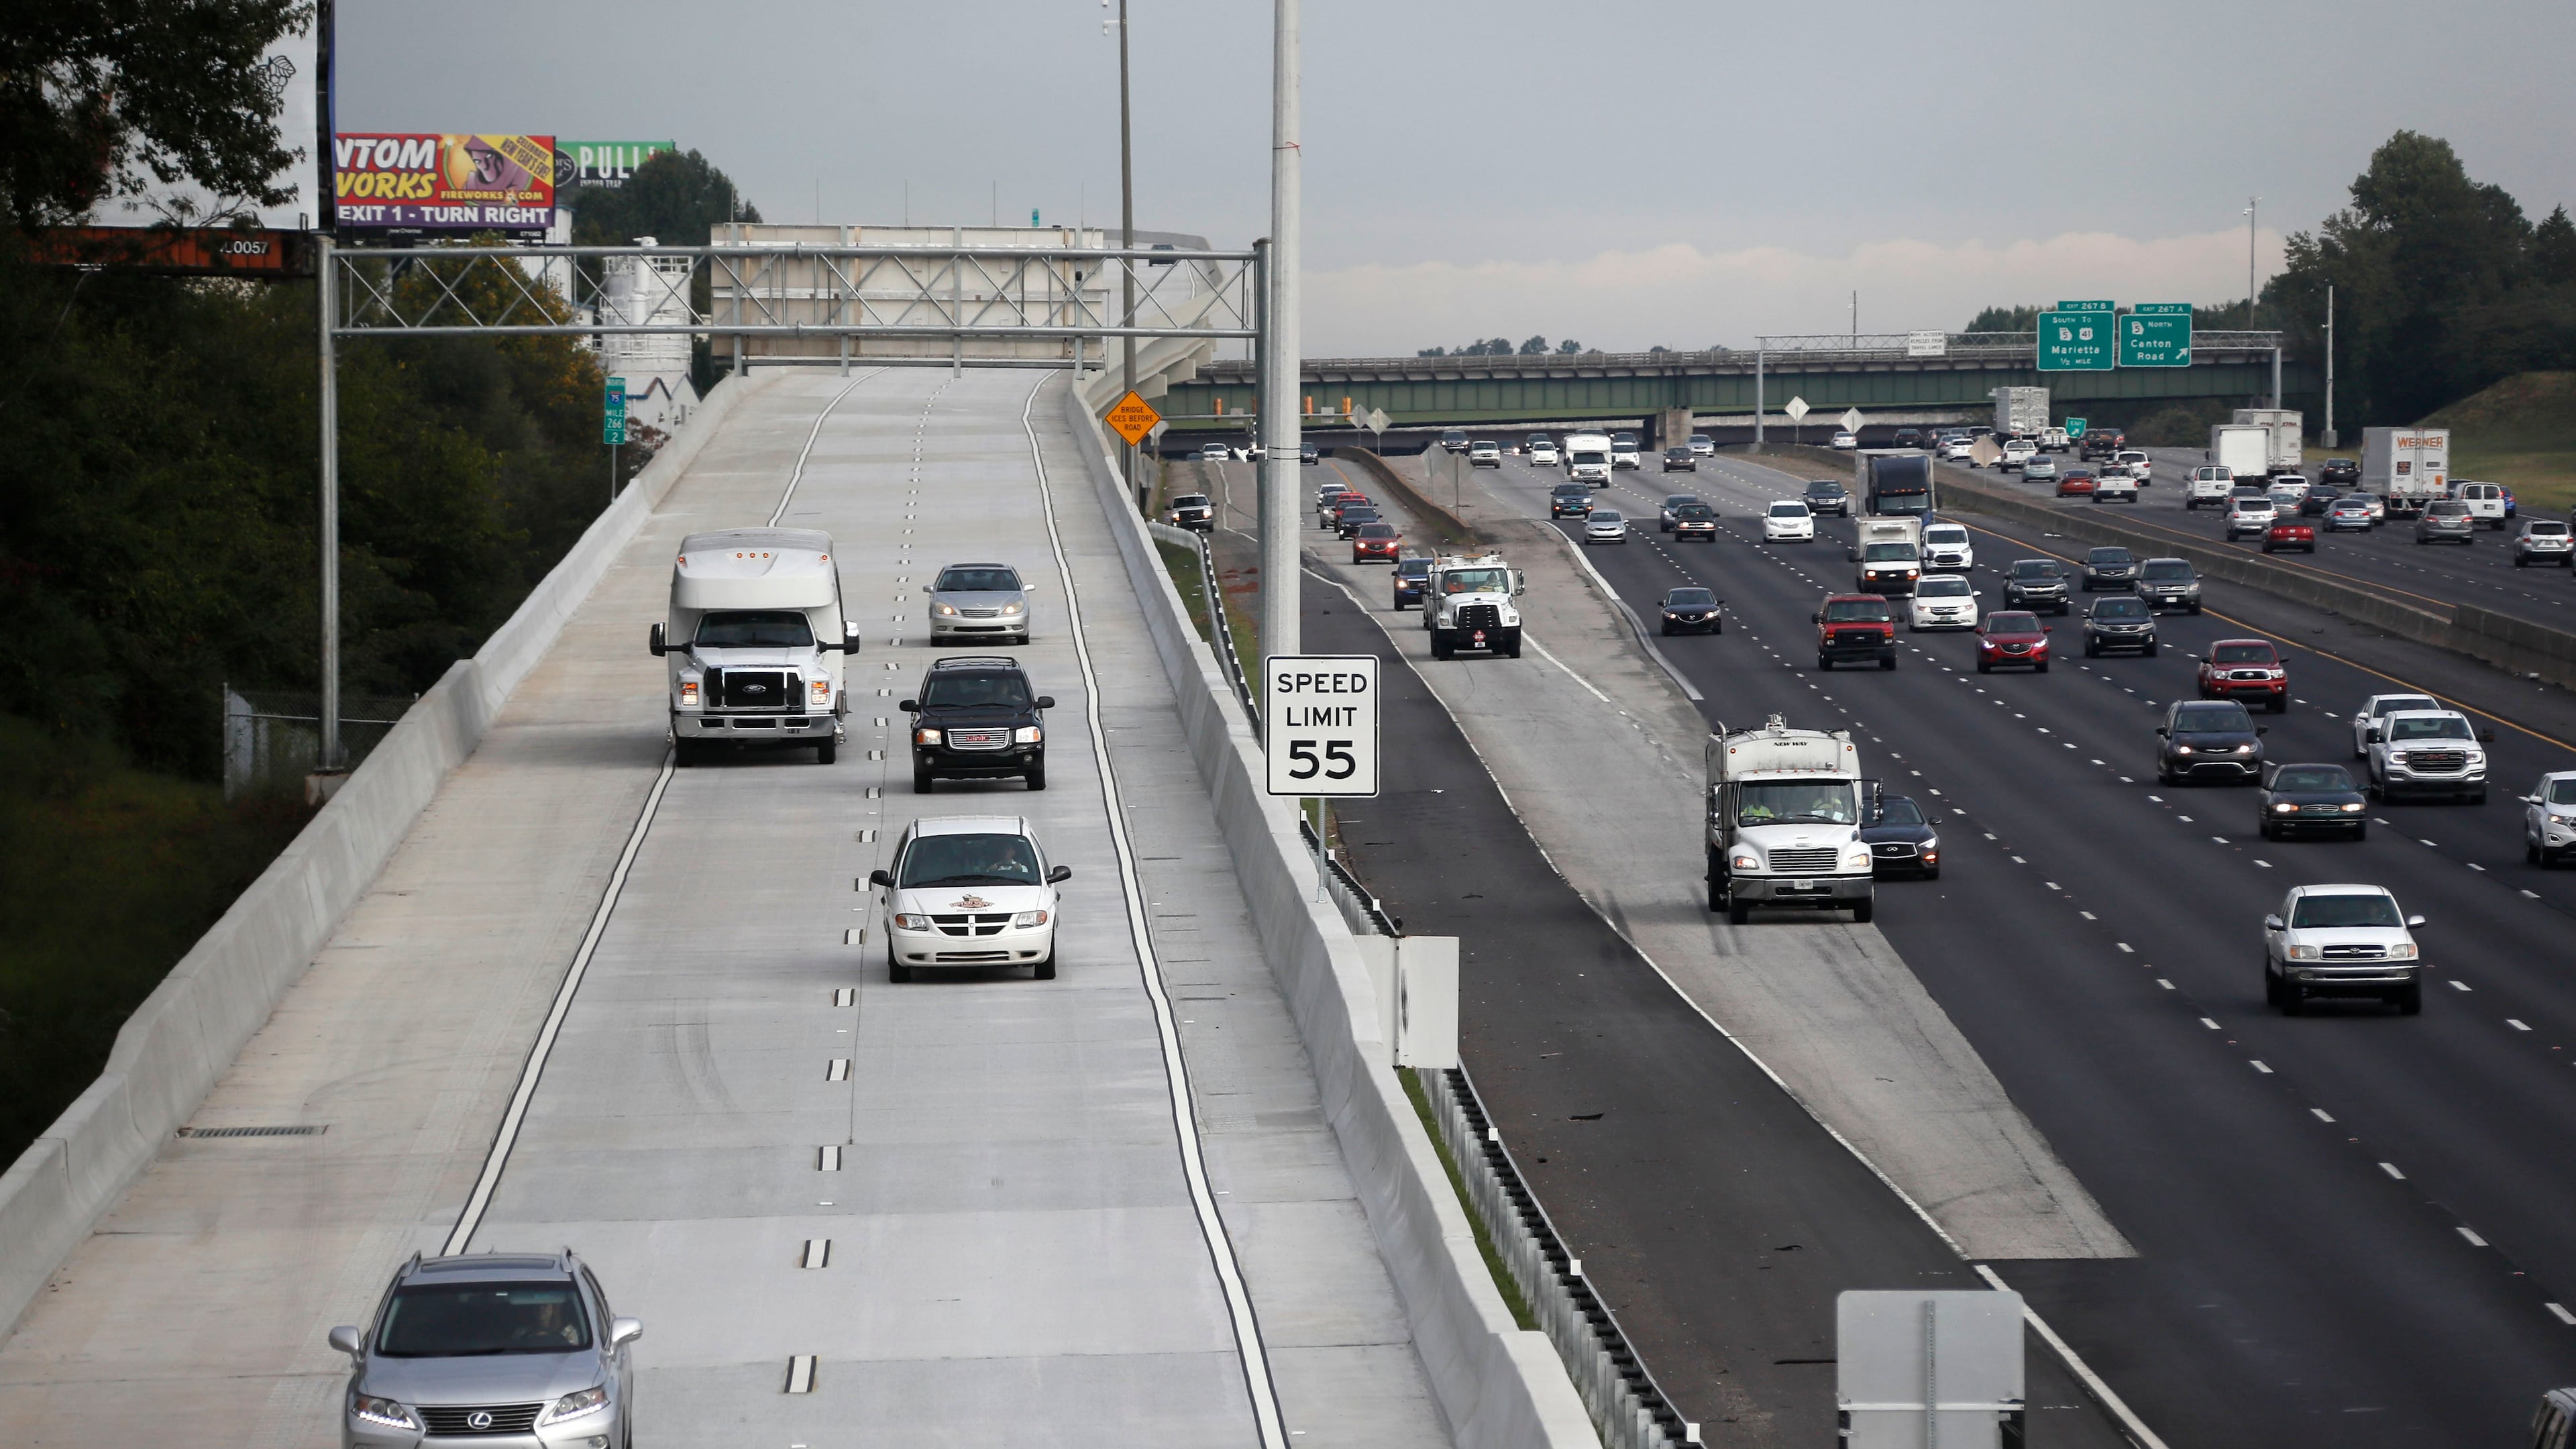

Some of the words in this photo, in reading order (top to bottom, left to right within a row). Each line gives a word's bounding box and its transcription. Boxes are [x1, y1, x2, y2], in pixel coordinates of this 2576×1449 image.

[440, 191, 502, 199] FIREWORKS
[339, 206, 385, 221] EXIT
[392, 207, 401, 221] 1
[420, 207, 478, 222] TURN
[485, 207, 549, 223] RIGHT
[2131, 339, 2171, 348] Canton
[2051, 345, 2100, 354] Marietta
[2137, 352, 2164, 360] Road
[611, 394, 619, 402] 75
[607, 418, 623, 429] 266
[610, 431, 619, 443] 2
[2398, 436, 2443, 448] WERNER
[1277, 673, 1367, 693] SPEED
[1287, 706, 1357, 727] LIMIT
[1289, 740, 1356, 780] 55
